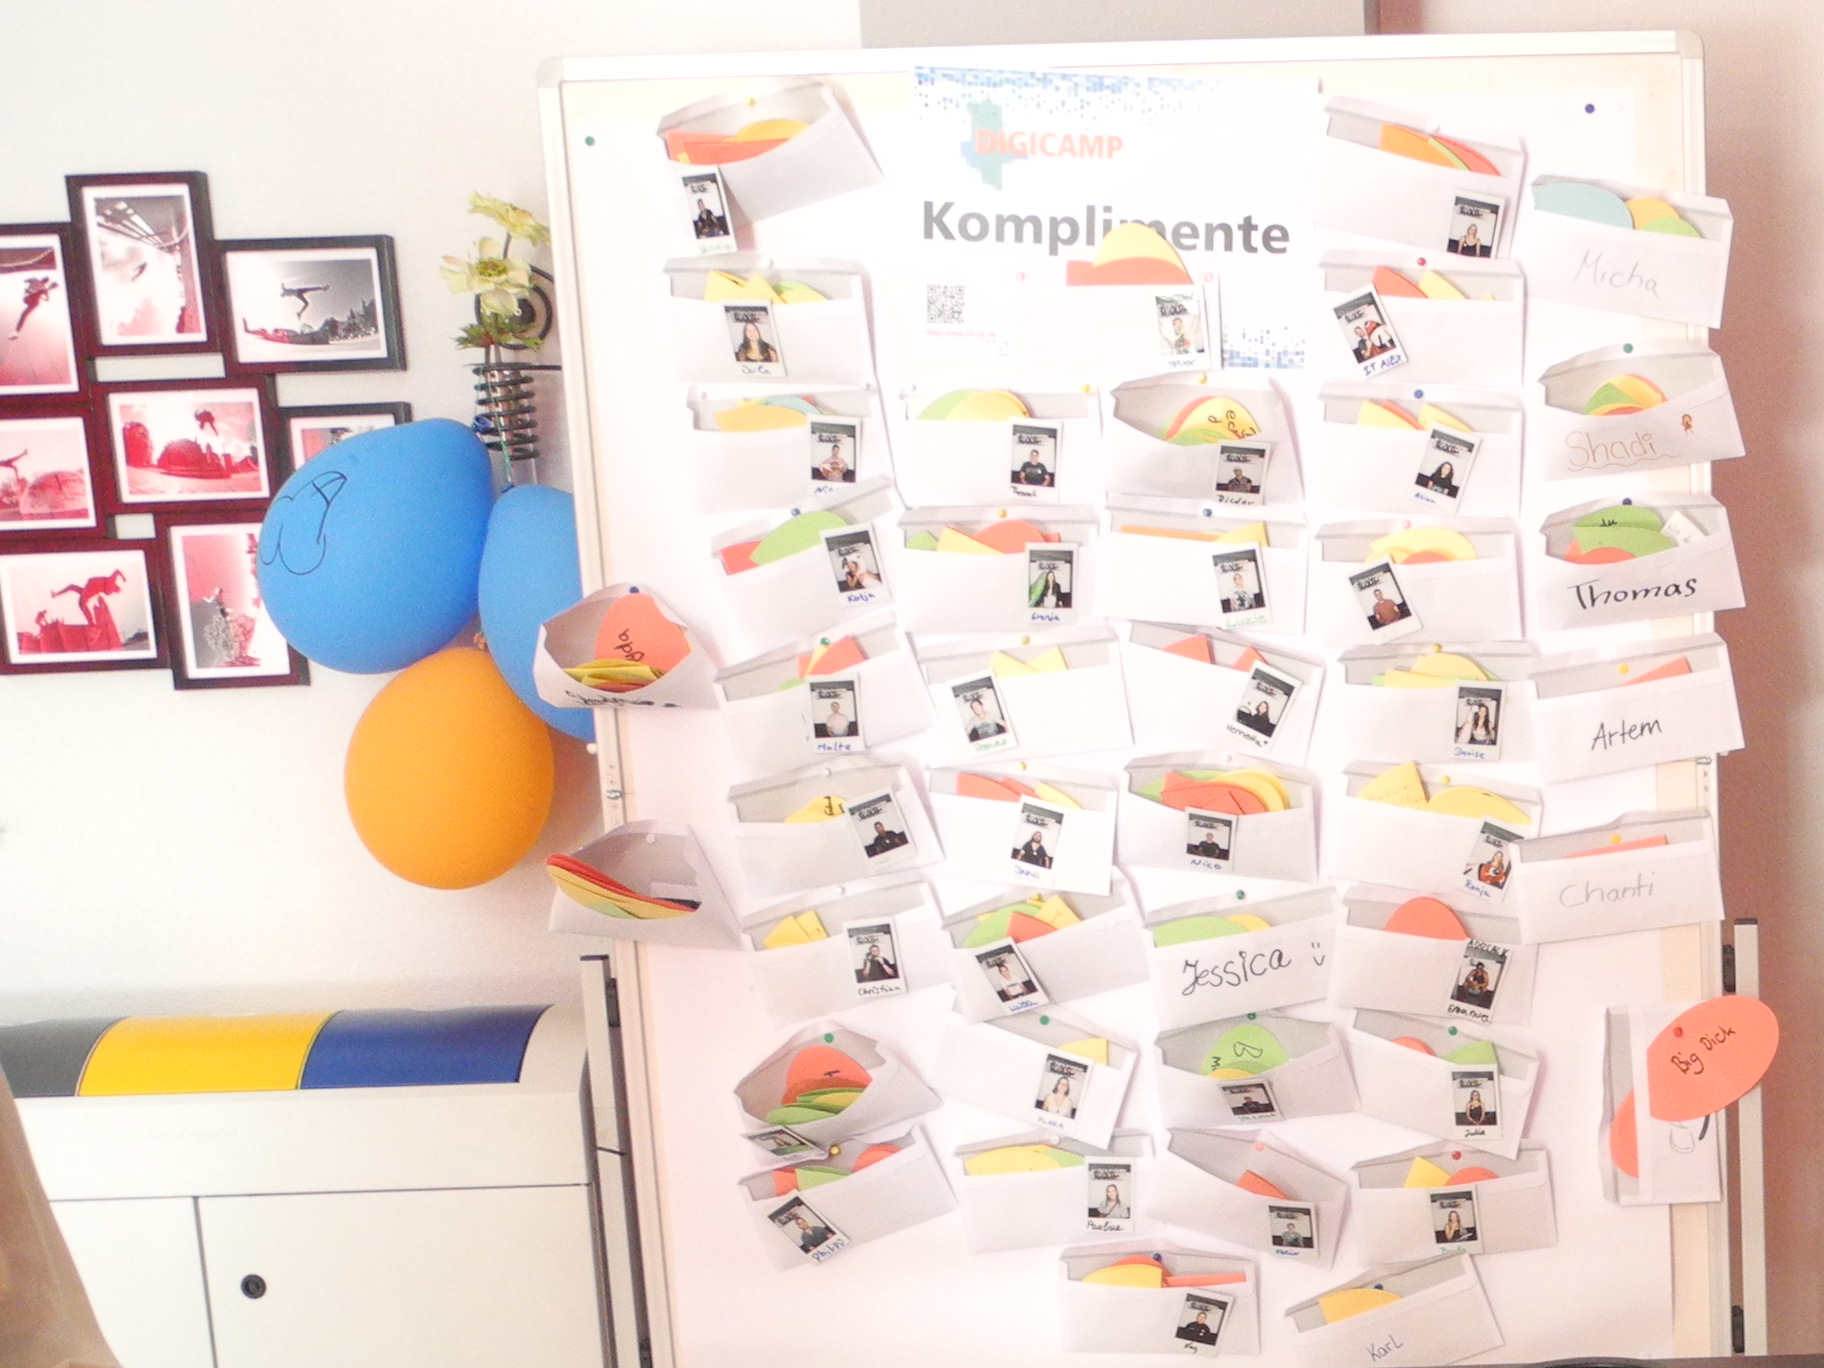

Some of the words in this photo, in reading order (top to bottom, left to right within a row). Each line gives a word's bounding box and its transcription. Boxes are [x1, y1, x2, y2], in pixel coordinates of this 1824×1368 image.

[975, 129, 1124, 159] DIGICAMP
[1573, 249, 1660, 300] Micha
[1565, 430, 1660, 469] Shadi
[1566, 576, 1698, 611] Thomas
[1589, 717, 1663, 751] Artem
[1558, 871, 1657, 908] Chanti
[1670, 1052, 1705, 1076] Big
[1698, 1025, 1737, 1052] Dick
